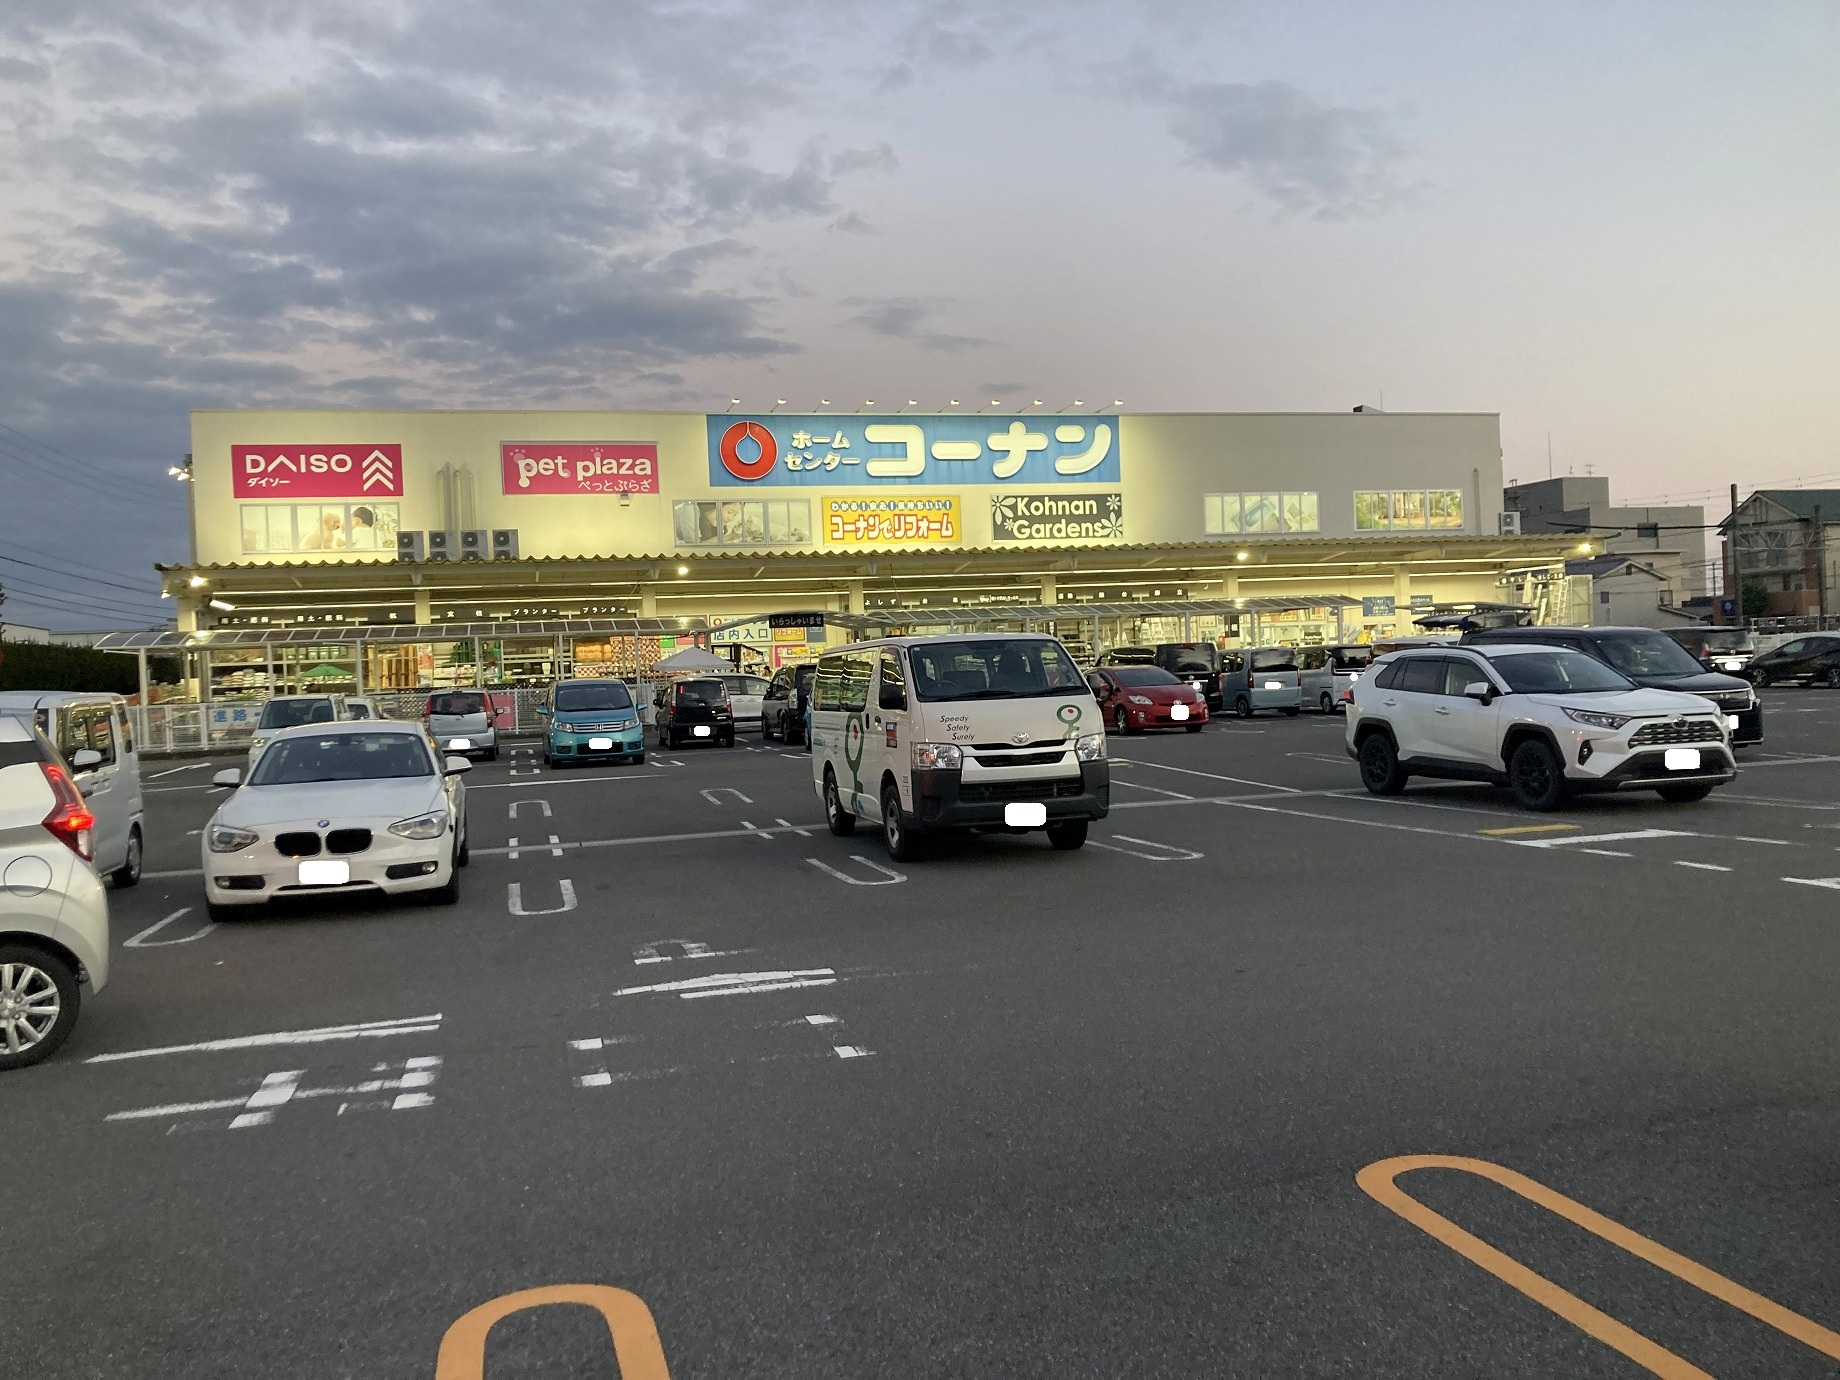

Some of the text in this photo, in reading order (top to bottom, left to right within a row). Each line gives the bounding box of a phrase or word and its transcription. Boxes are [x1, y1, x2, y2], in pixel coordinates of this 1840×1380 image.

[791, 429, 850, 449] ホーム
[865, 421, 1112, 478] コーナン
[245, 453, 353, 474] DAISO
[518, 455, 652, 488] pet plaza
[784, 451, 861, 472] センター
[247, 477, 290, 487] ダイソー
[578, 479, 652, 492] ぺっとぷらざ
[1016, 496, 1098, 516] Kohnan
[830, 513, 954, 540] コーナンでリフォーム
[1012, 518, 1104, 539] Gardens
[771, 617, 822, 626] いらっしゃいませ
[713, 628, 768, 640] 店内入口
[940, 715, 969, 723] Speedy
[946, 723, 970, 732] Safety
[952, 732, 975, 741] Surely
